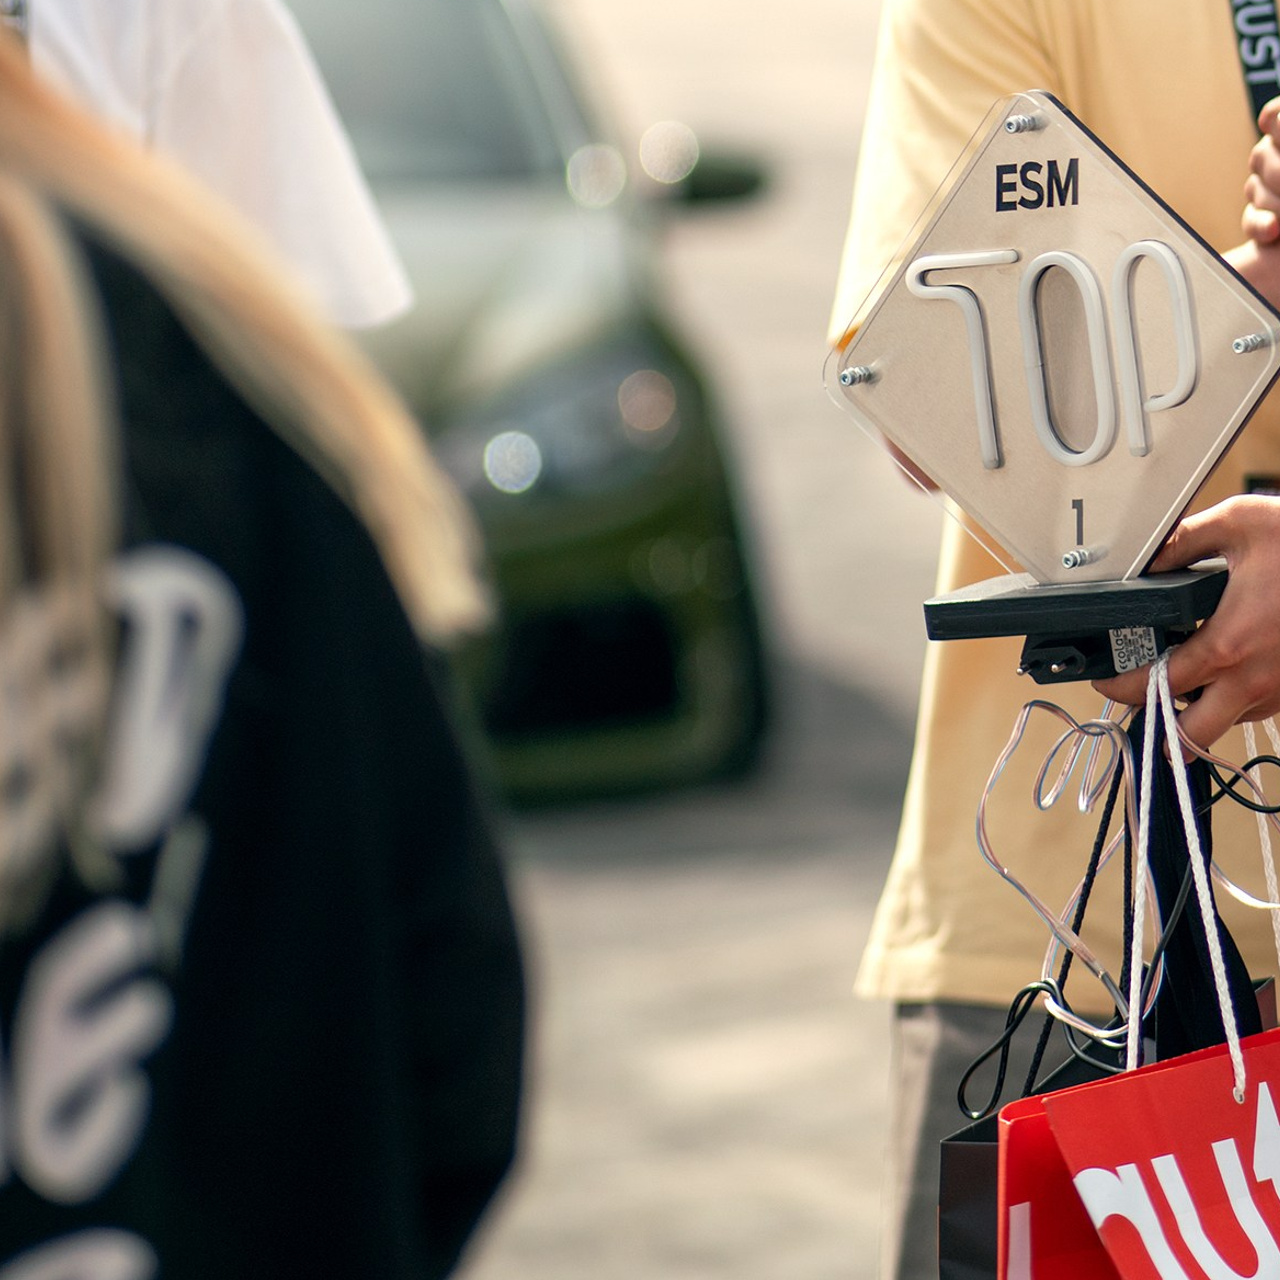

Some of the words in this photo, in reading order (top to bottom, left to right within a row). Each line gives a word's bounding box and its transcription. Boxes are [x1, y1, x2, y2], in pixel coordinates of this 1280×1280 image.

[995, 158, 1080, 213] ESM
[906, 240, 1197, 467] TOP
[1071, 499, 1085, 546] 1
